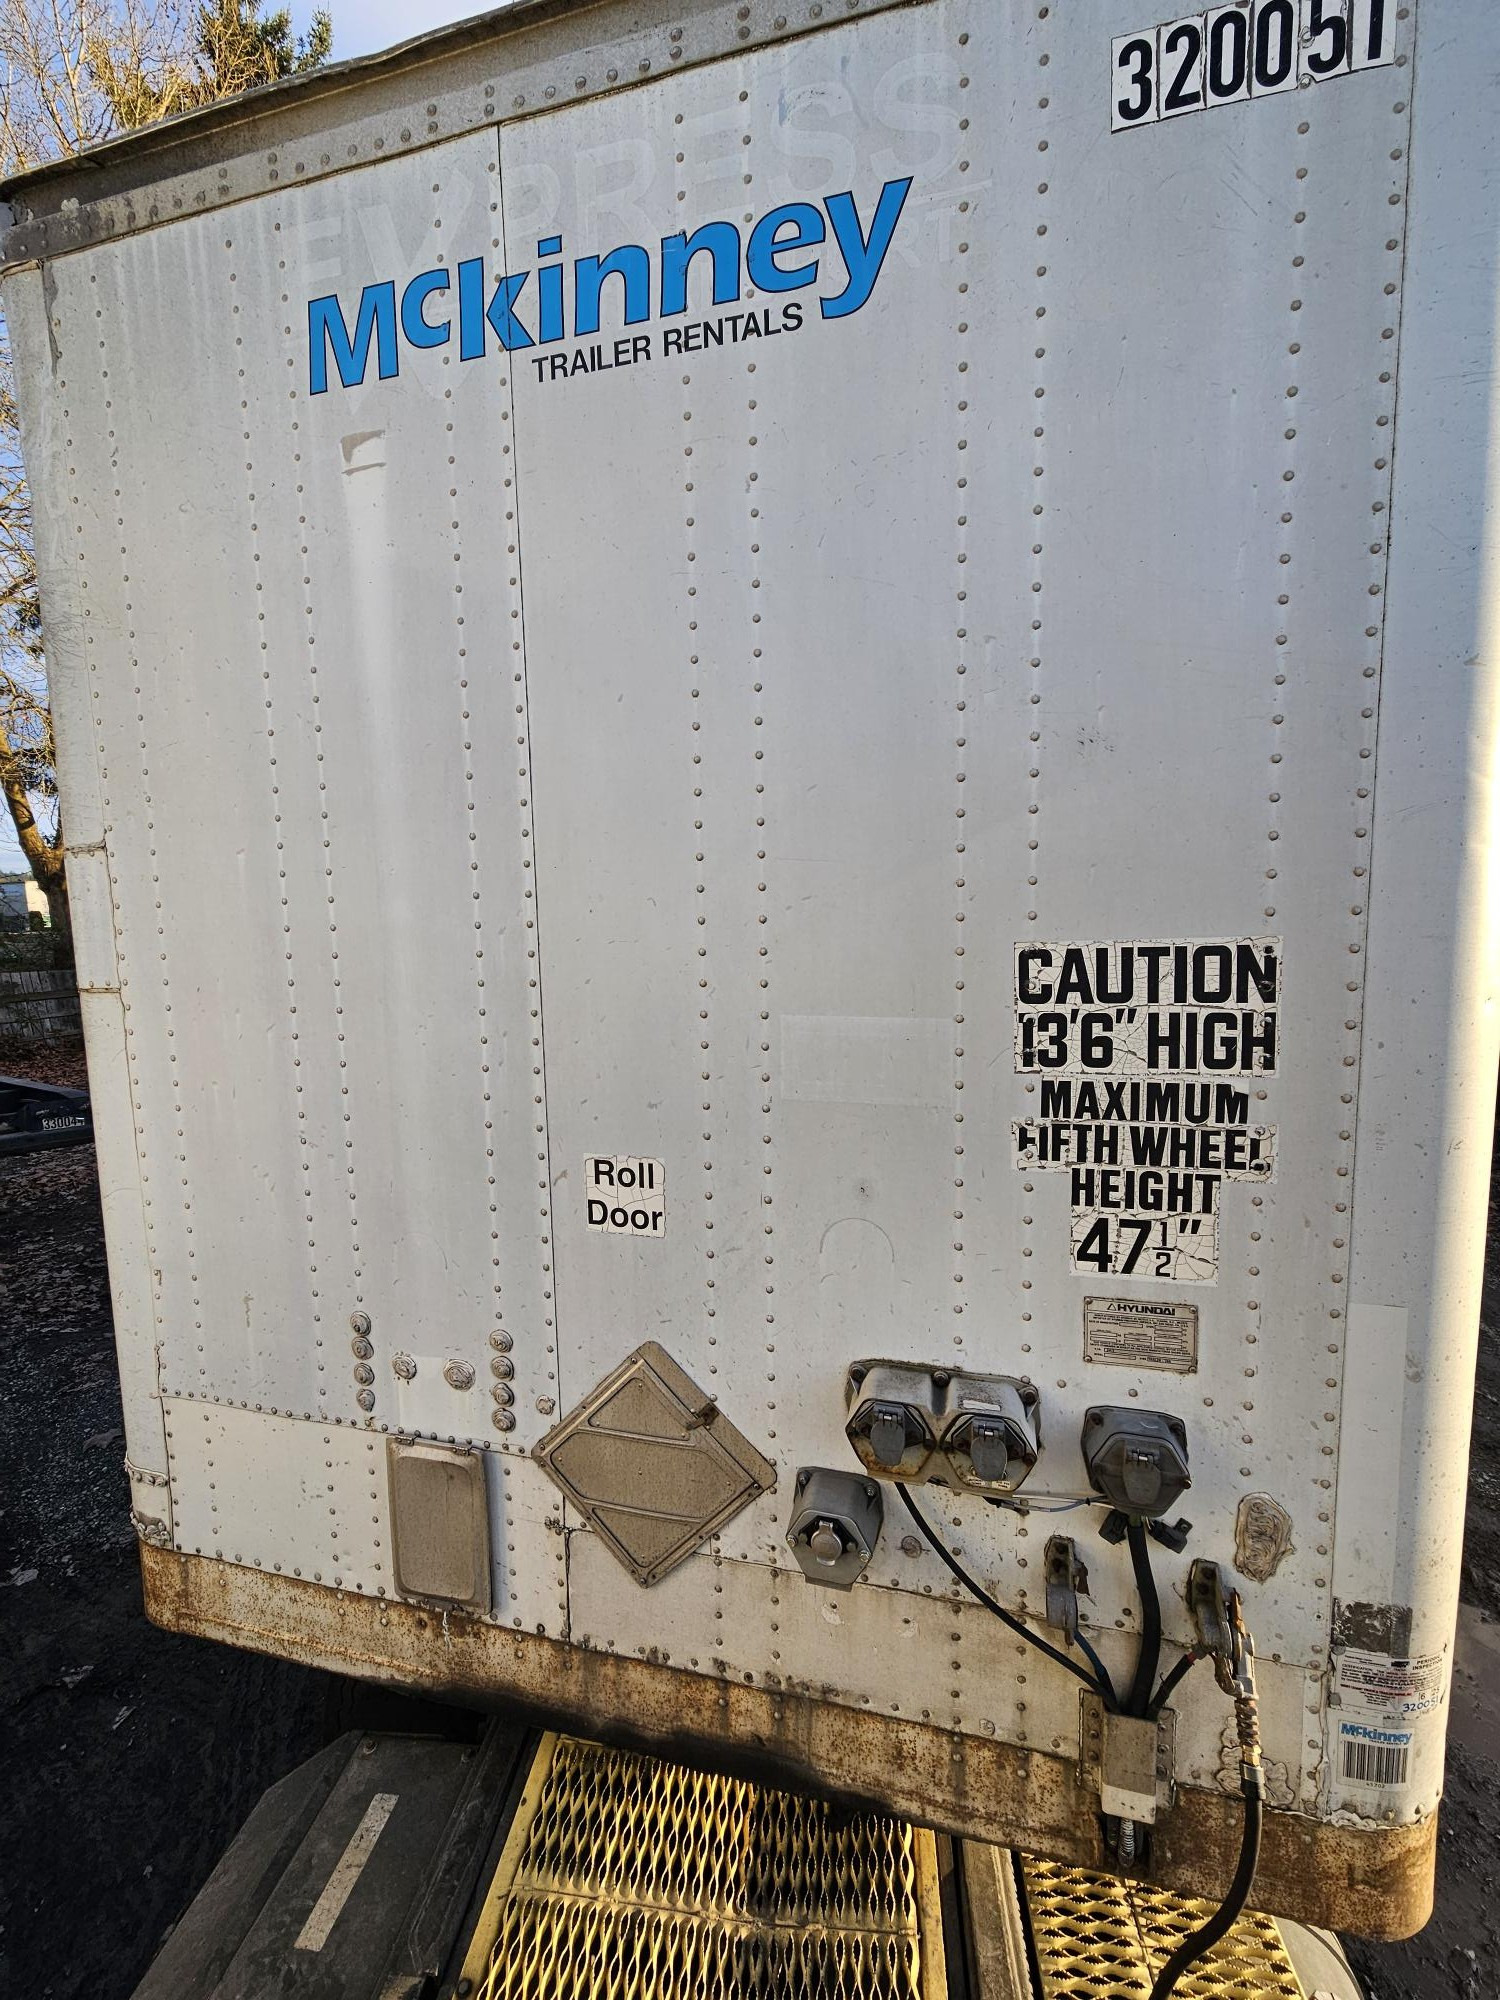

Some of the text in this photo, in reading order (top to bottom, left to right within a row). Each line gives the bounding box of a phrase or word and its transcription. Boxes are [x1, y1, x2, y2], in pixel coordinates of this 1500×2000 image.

[1118, 0, 1385, 121] 320051
[531, 302, 805, 384] TRAILER RENTALS
[1018, 944, 1278, 1005] CAUTION
[1147, 1011, 1277, 1071] HIGH
[1040, 1079, 1249, 1124] MAXIMUM
[1018, 1123, 1270, 1171] FIFTH WHEEL
[594, 1158, 654, 1190] Roll
[1071, 1167, 1222, 1214] HEIGHT
[587, 1198, 663, 1231] Door
[1117, 1303, 1176, 1316] HYUNDAI
[1402, 1695, 1439, 1713] 320051
